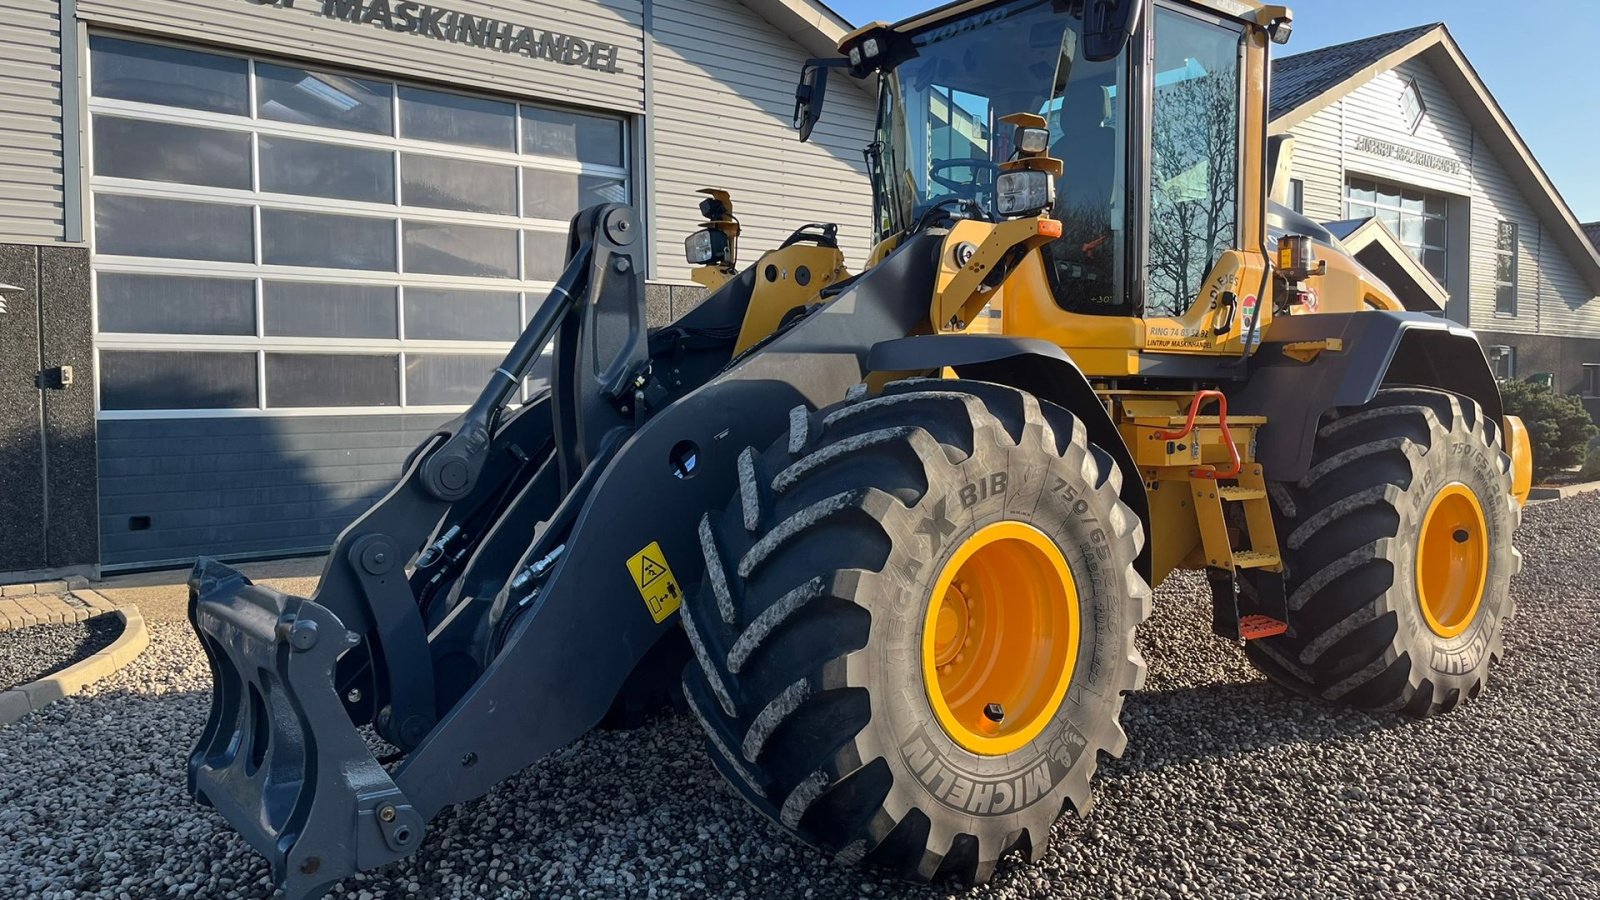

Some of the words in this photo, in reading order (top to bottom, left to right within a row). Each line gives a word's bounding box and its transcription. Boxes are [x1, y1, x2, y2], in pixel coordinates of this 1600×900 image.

[322, 0, 622, 73] MASKINHANDEL
[1147, 339, 1170, 348] LINTRUP
[1150, 327, 1169, 337] RING
[1170, 328, 1179, 337] 74
[1432, 608, 1498, 674] MICHELIN
[902, 736, 1052, 814] MICHELIN
